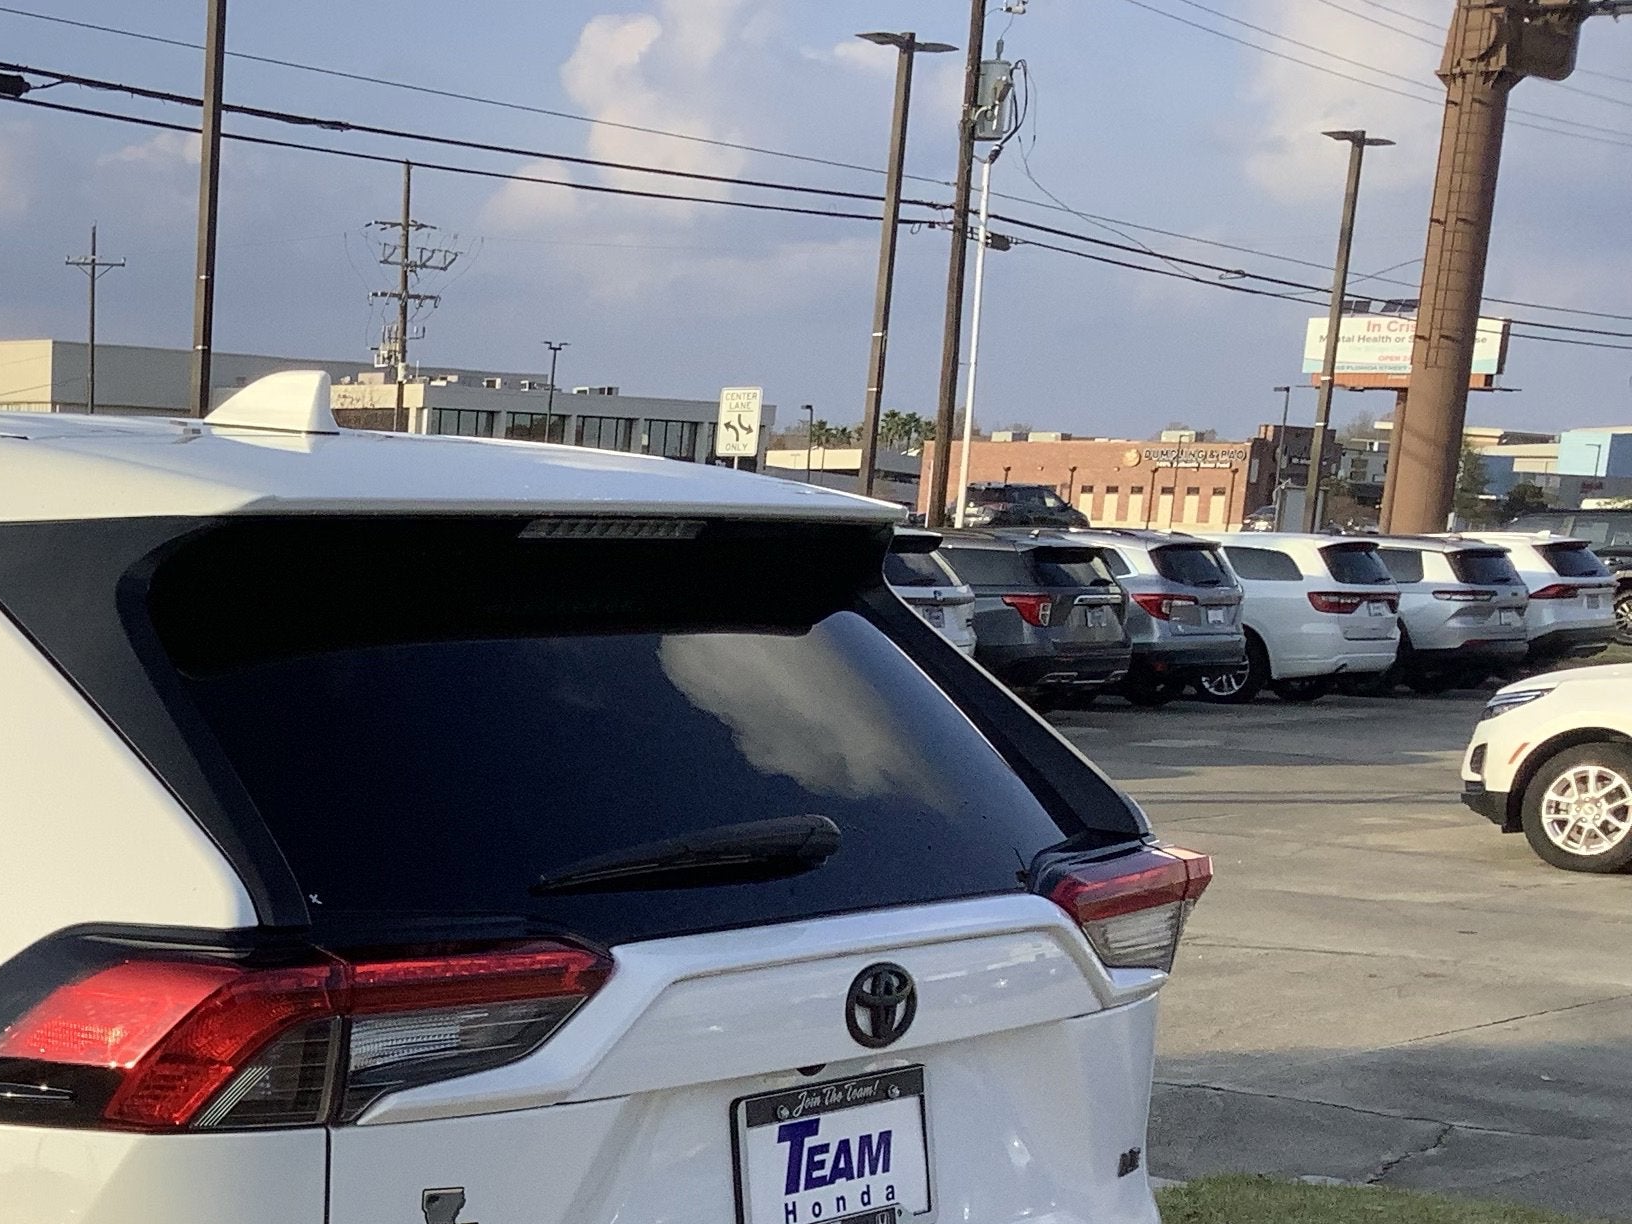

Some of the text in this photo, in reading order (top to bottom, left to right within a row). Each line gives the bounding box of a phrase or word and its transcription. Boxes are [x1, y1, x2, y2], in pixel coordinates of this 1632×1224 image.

[1366, 320, 1416, 332] In Cris
[1357, 335, 1392, 343] Health
[725, 392, 758, 401] CENTER
[729, 402, 751, 410] LANE
[725, 443, 748, 452] ONLY
[792, 1080, 880, 1118] Join The Team!
[777, 1117, 893, 1196] TEAM
[784, 1184, 896, 1224] Honda
